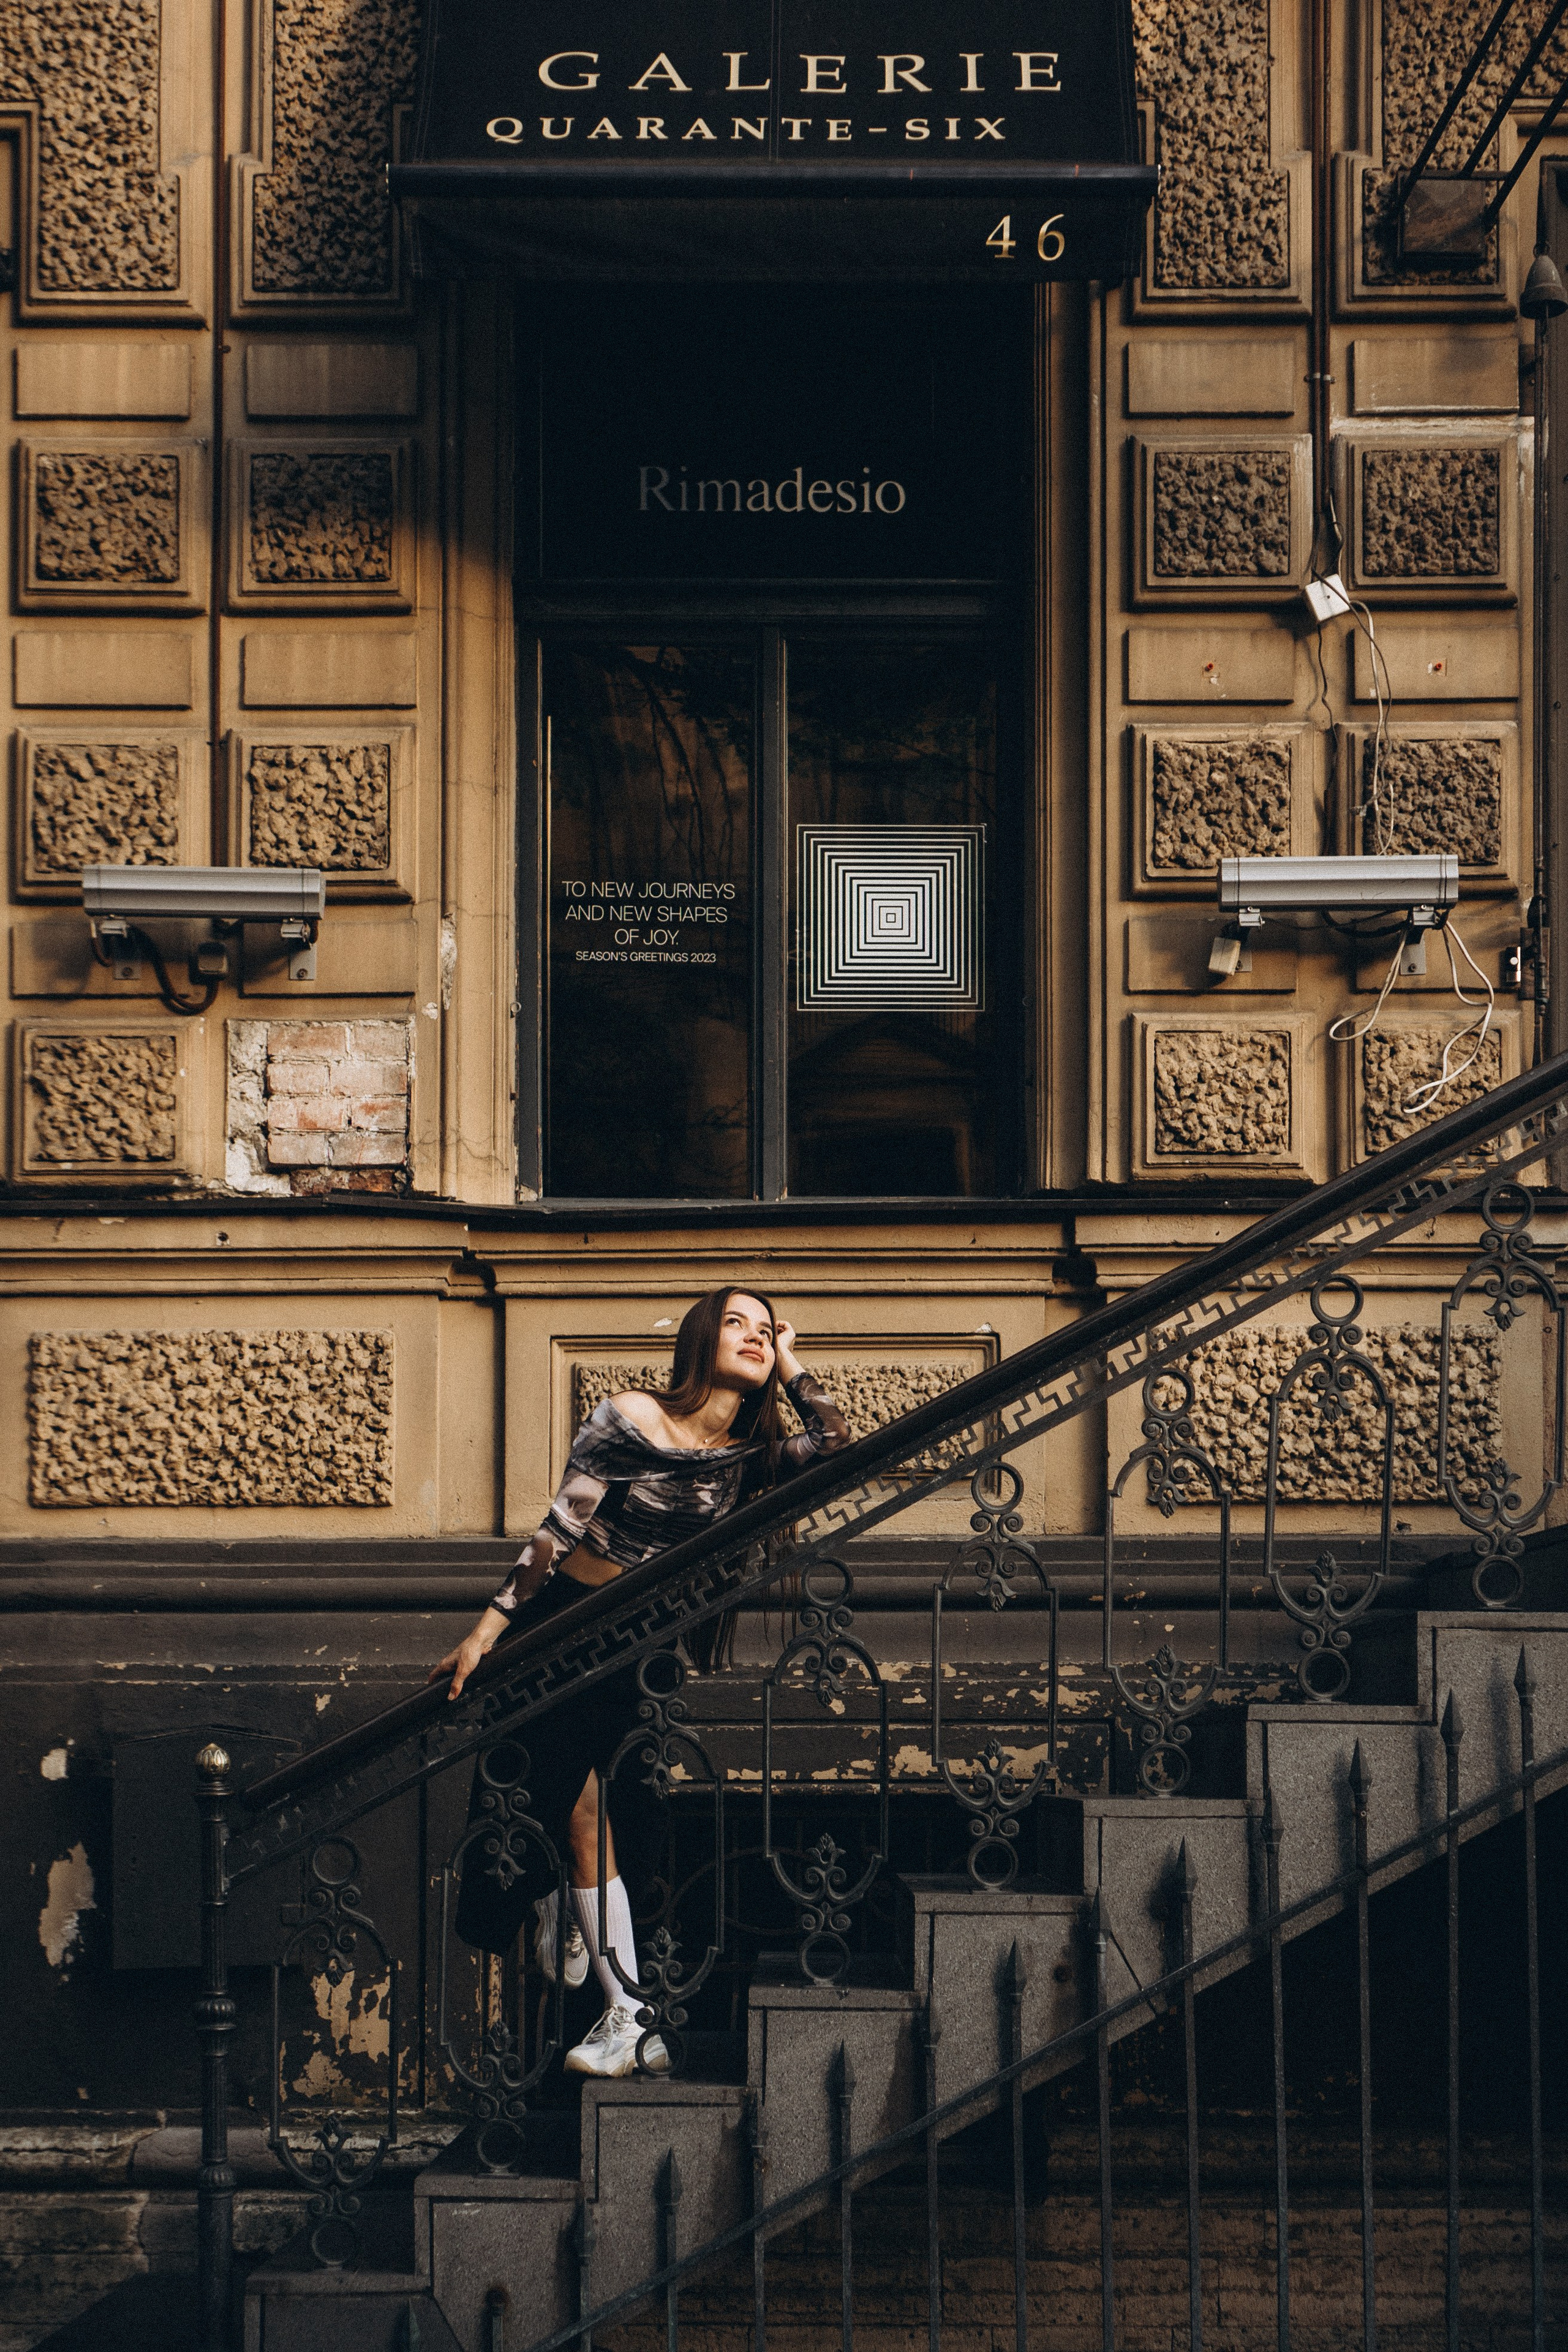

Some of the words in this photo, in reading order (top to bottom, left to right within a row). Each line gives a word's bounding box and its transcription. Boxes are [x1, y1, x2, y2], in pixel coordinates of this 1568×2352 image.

[537, 51, 1062, 94] GALERIE
[485, 116, 1006, 145] QUARANTE-SIX
[985, 213, 1066, 262] 46
[638, 466, 907, 514] Rimadesio
[562, 881, 586, 897] TO
[591, 881, 635, 899] NEW
[638, 882, 736, 900] JOURNEYS
[565, 905, 605, 921] AND
[609, 905, 653, 922] NEW
[657, 905, 728, 924] SHAPES
[614, 928, 639, 945] OF
[643, 929, 679, 946] JOY.
[575, 951, 628, 962] SEASON'S
[629, 951, 689, 963] GREETINGS
[690, 952, 717, 963] 2023
